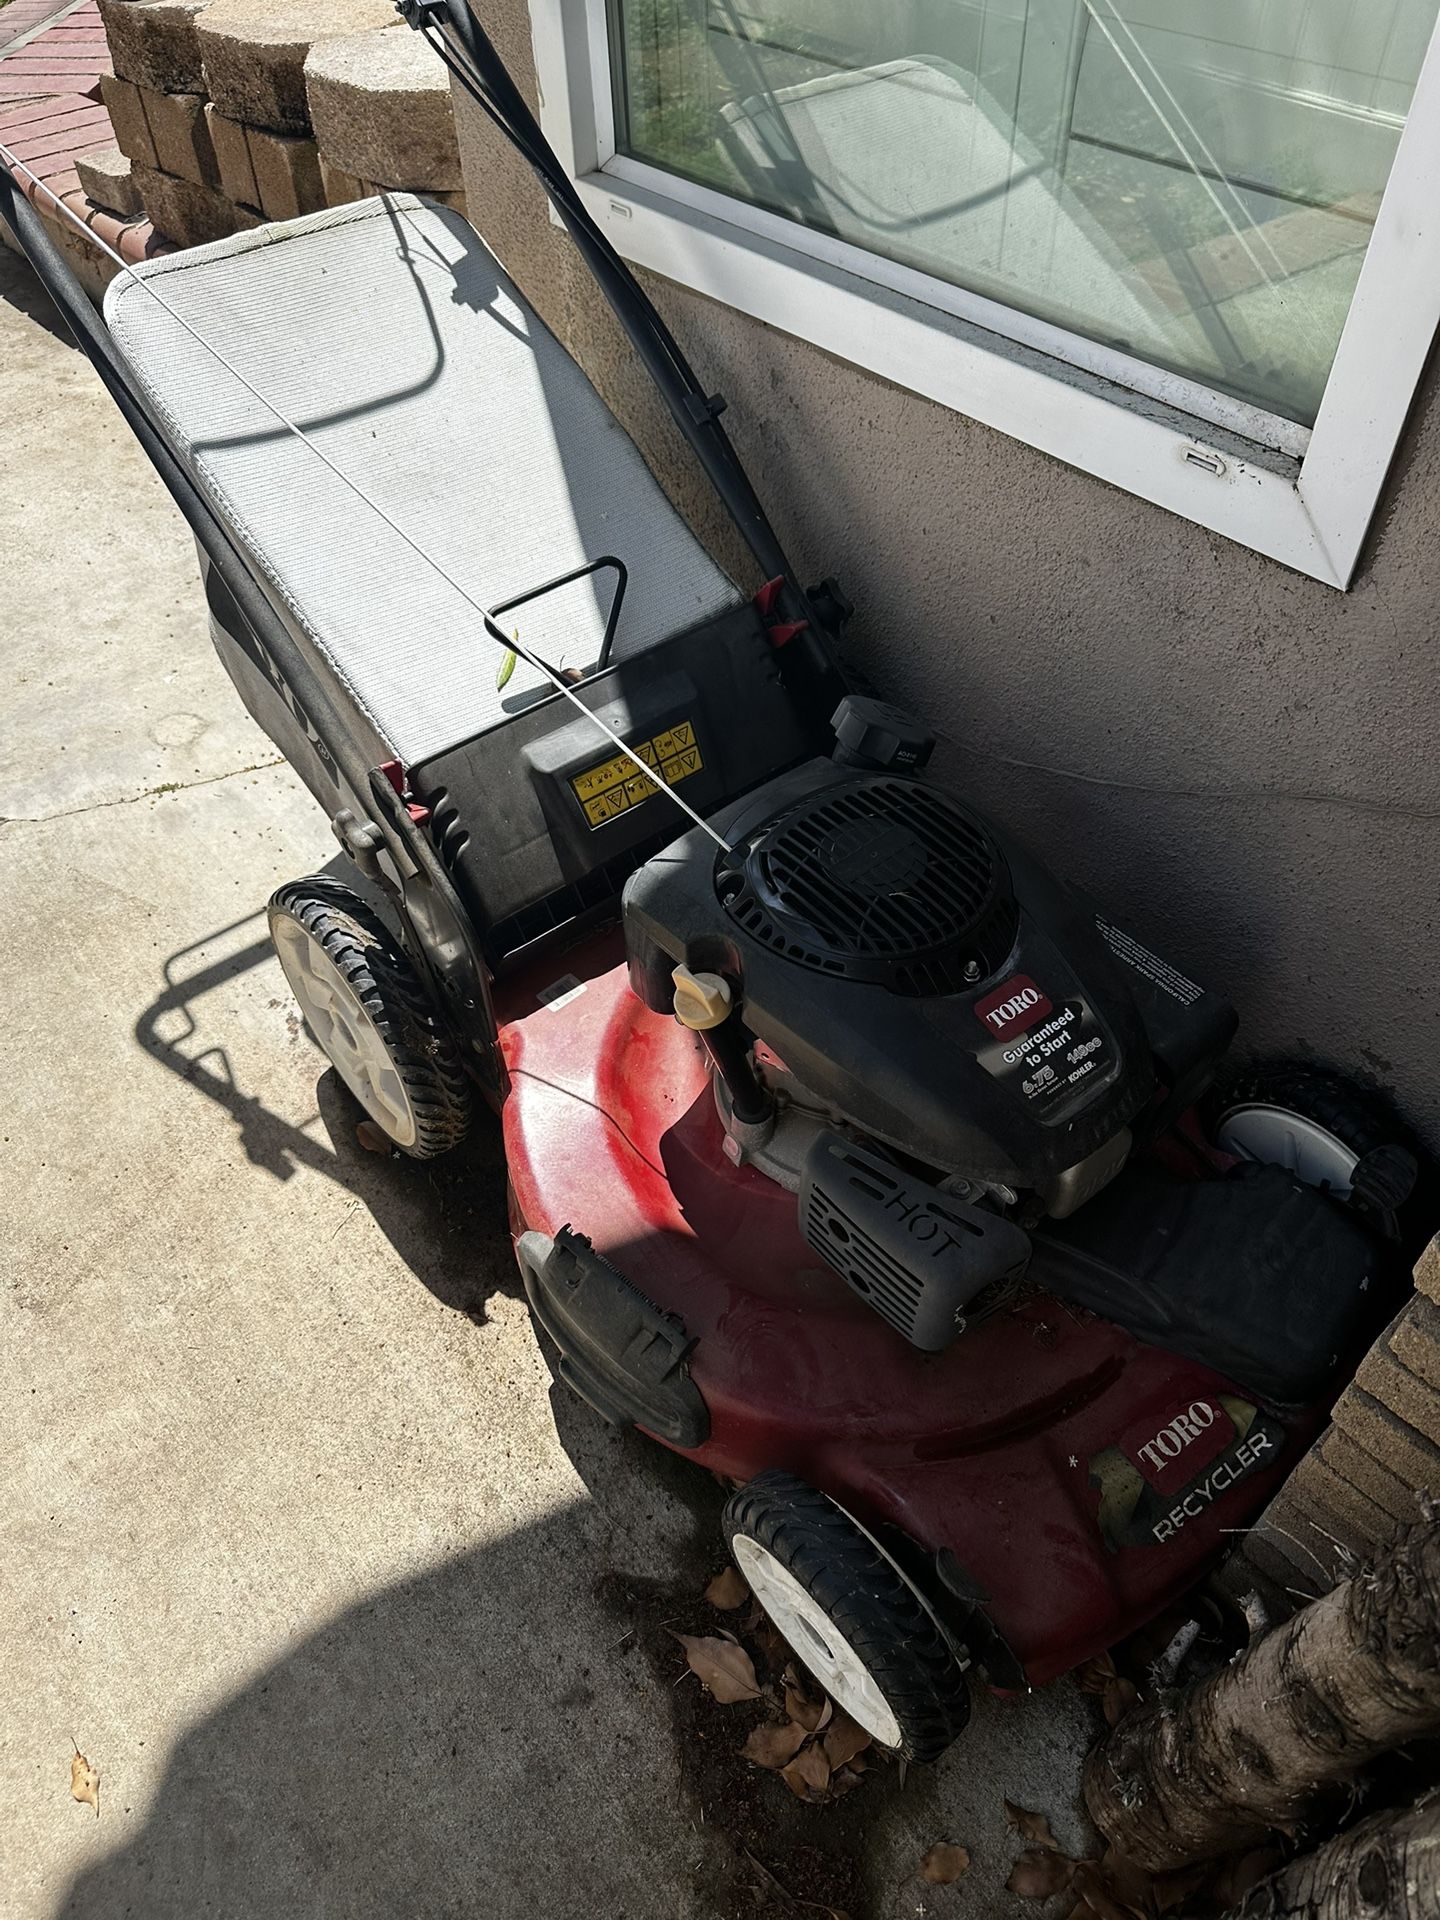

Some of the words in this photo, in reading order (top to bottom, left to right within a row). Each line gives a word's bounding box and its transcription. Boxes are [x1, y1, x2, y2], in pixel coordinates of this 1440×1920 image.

[1136, 964, 1156, 980] SPARK
[986, 987, 1039, 1029] TORO
[1155, 978, 1190, 1006] CALIFORNIA
[1003, 1008, 1076, 1064] Guaranteed
[1025, 1054, 1041, 1067] to
[1040, 1030, 1071, 1056] Start
[1022, 1065, 1055, 1094] 6.75
[1068, 1060, 1094, 1083] KOHLER
[884, 1191, 962, 1258] HOT
[1137, 1401, 1216, 1473] TORO
[1151, 1432, 1274, 1544] RECYCLER
